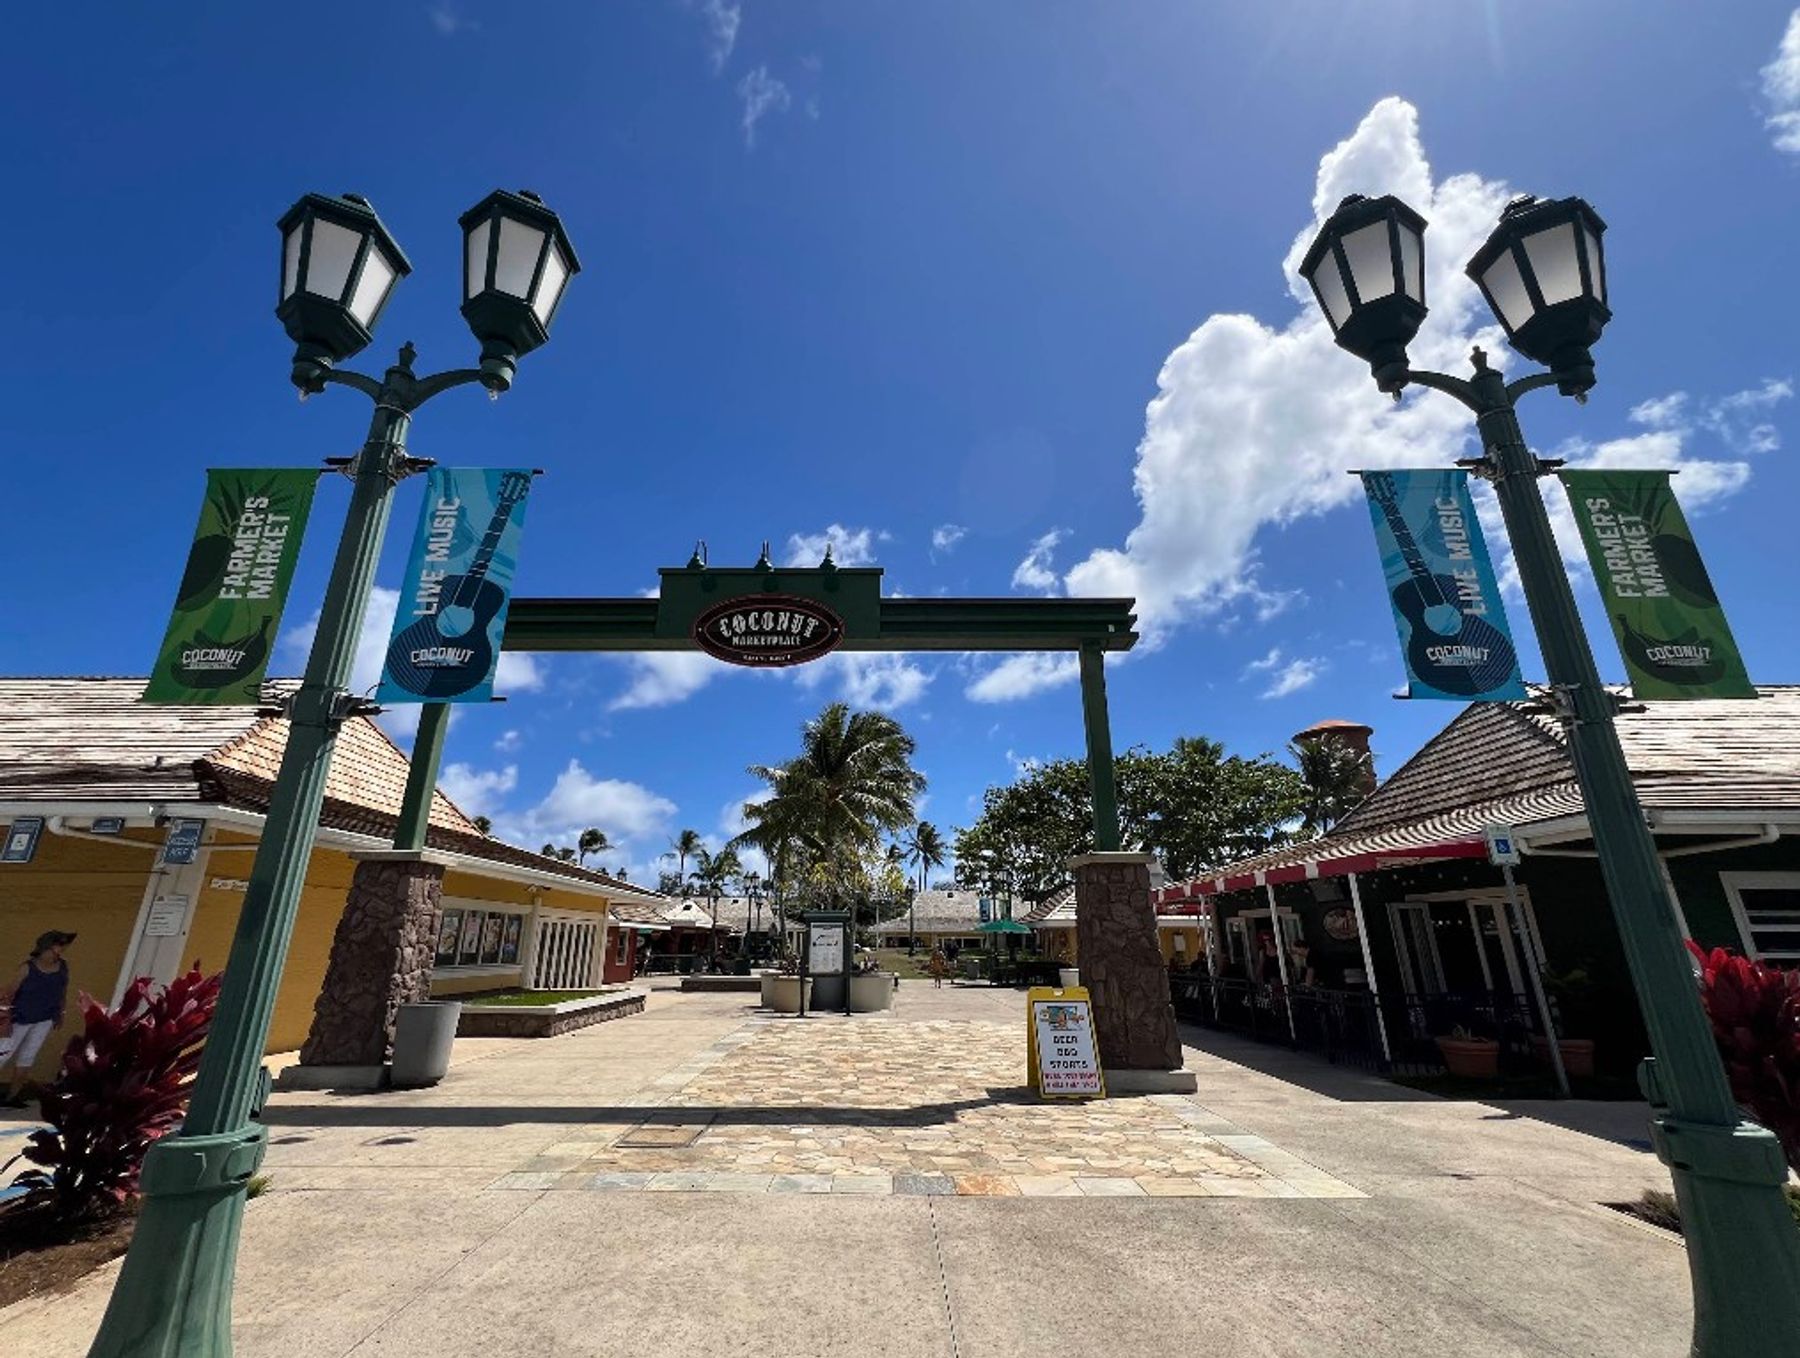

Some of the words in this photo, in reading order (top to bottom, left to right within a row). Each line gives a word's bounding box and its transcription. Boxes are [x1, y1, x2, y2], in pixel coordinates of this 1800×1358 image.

[219, 496, 269, 600] FARMER'S
[426, 497, 461, 563] MUSIC
[1437, 496, 1472, 561] MUSIC
[1585, 497, 1641, 599] FARMER'S
[246, 512, 291, 600] MARKET
[1619, 514, 1670, 599] MARKET
[413, 569, 445, 616] LIVE
[1453, 569, 1487, 616] LIVE
[719, 611, 819, 638] COCONUT
[182, 649, 246, 664] COCONUT
[411, 647, 475, 663] COCONUT
[1425, 645, 1490, 661] COCONUT
[1645, 645, 1711, 661] COCONUT
[1050, 1060, 1088, 1069] SPORTS
